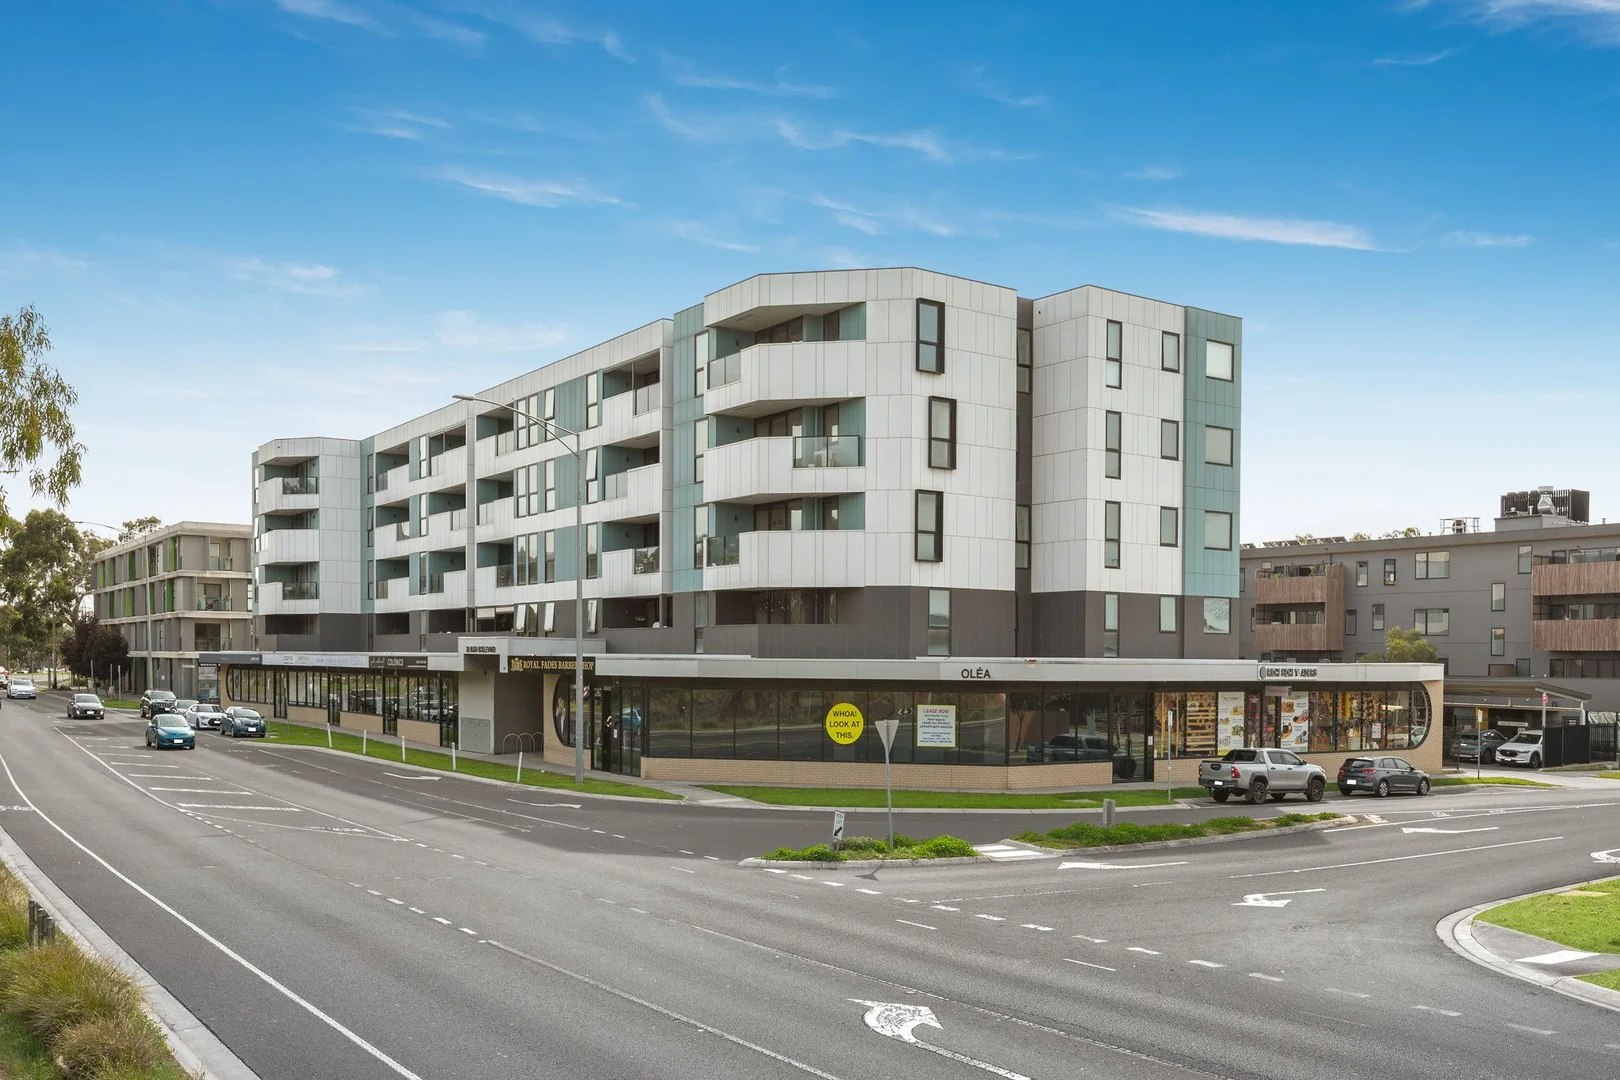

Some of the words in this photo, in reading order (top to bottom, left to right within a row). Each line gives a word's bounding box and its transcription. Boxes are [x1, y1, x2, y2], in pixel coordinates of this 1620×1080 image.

[522, 660, 540, 669] ROYAL
[541, 660, 558, 670] FADES
[558, 661, 577, 670] BARBE
[581, 662, 595, 670] HOP
[961, 667, 991, 679] OLÉA
[829, 720, 850, 728] LOOK
